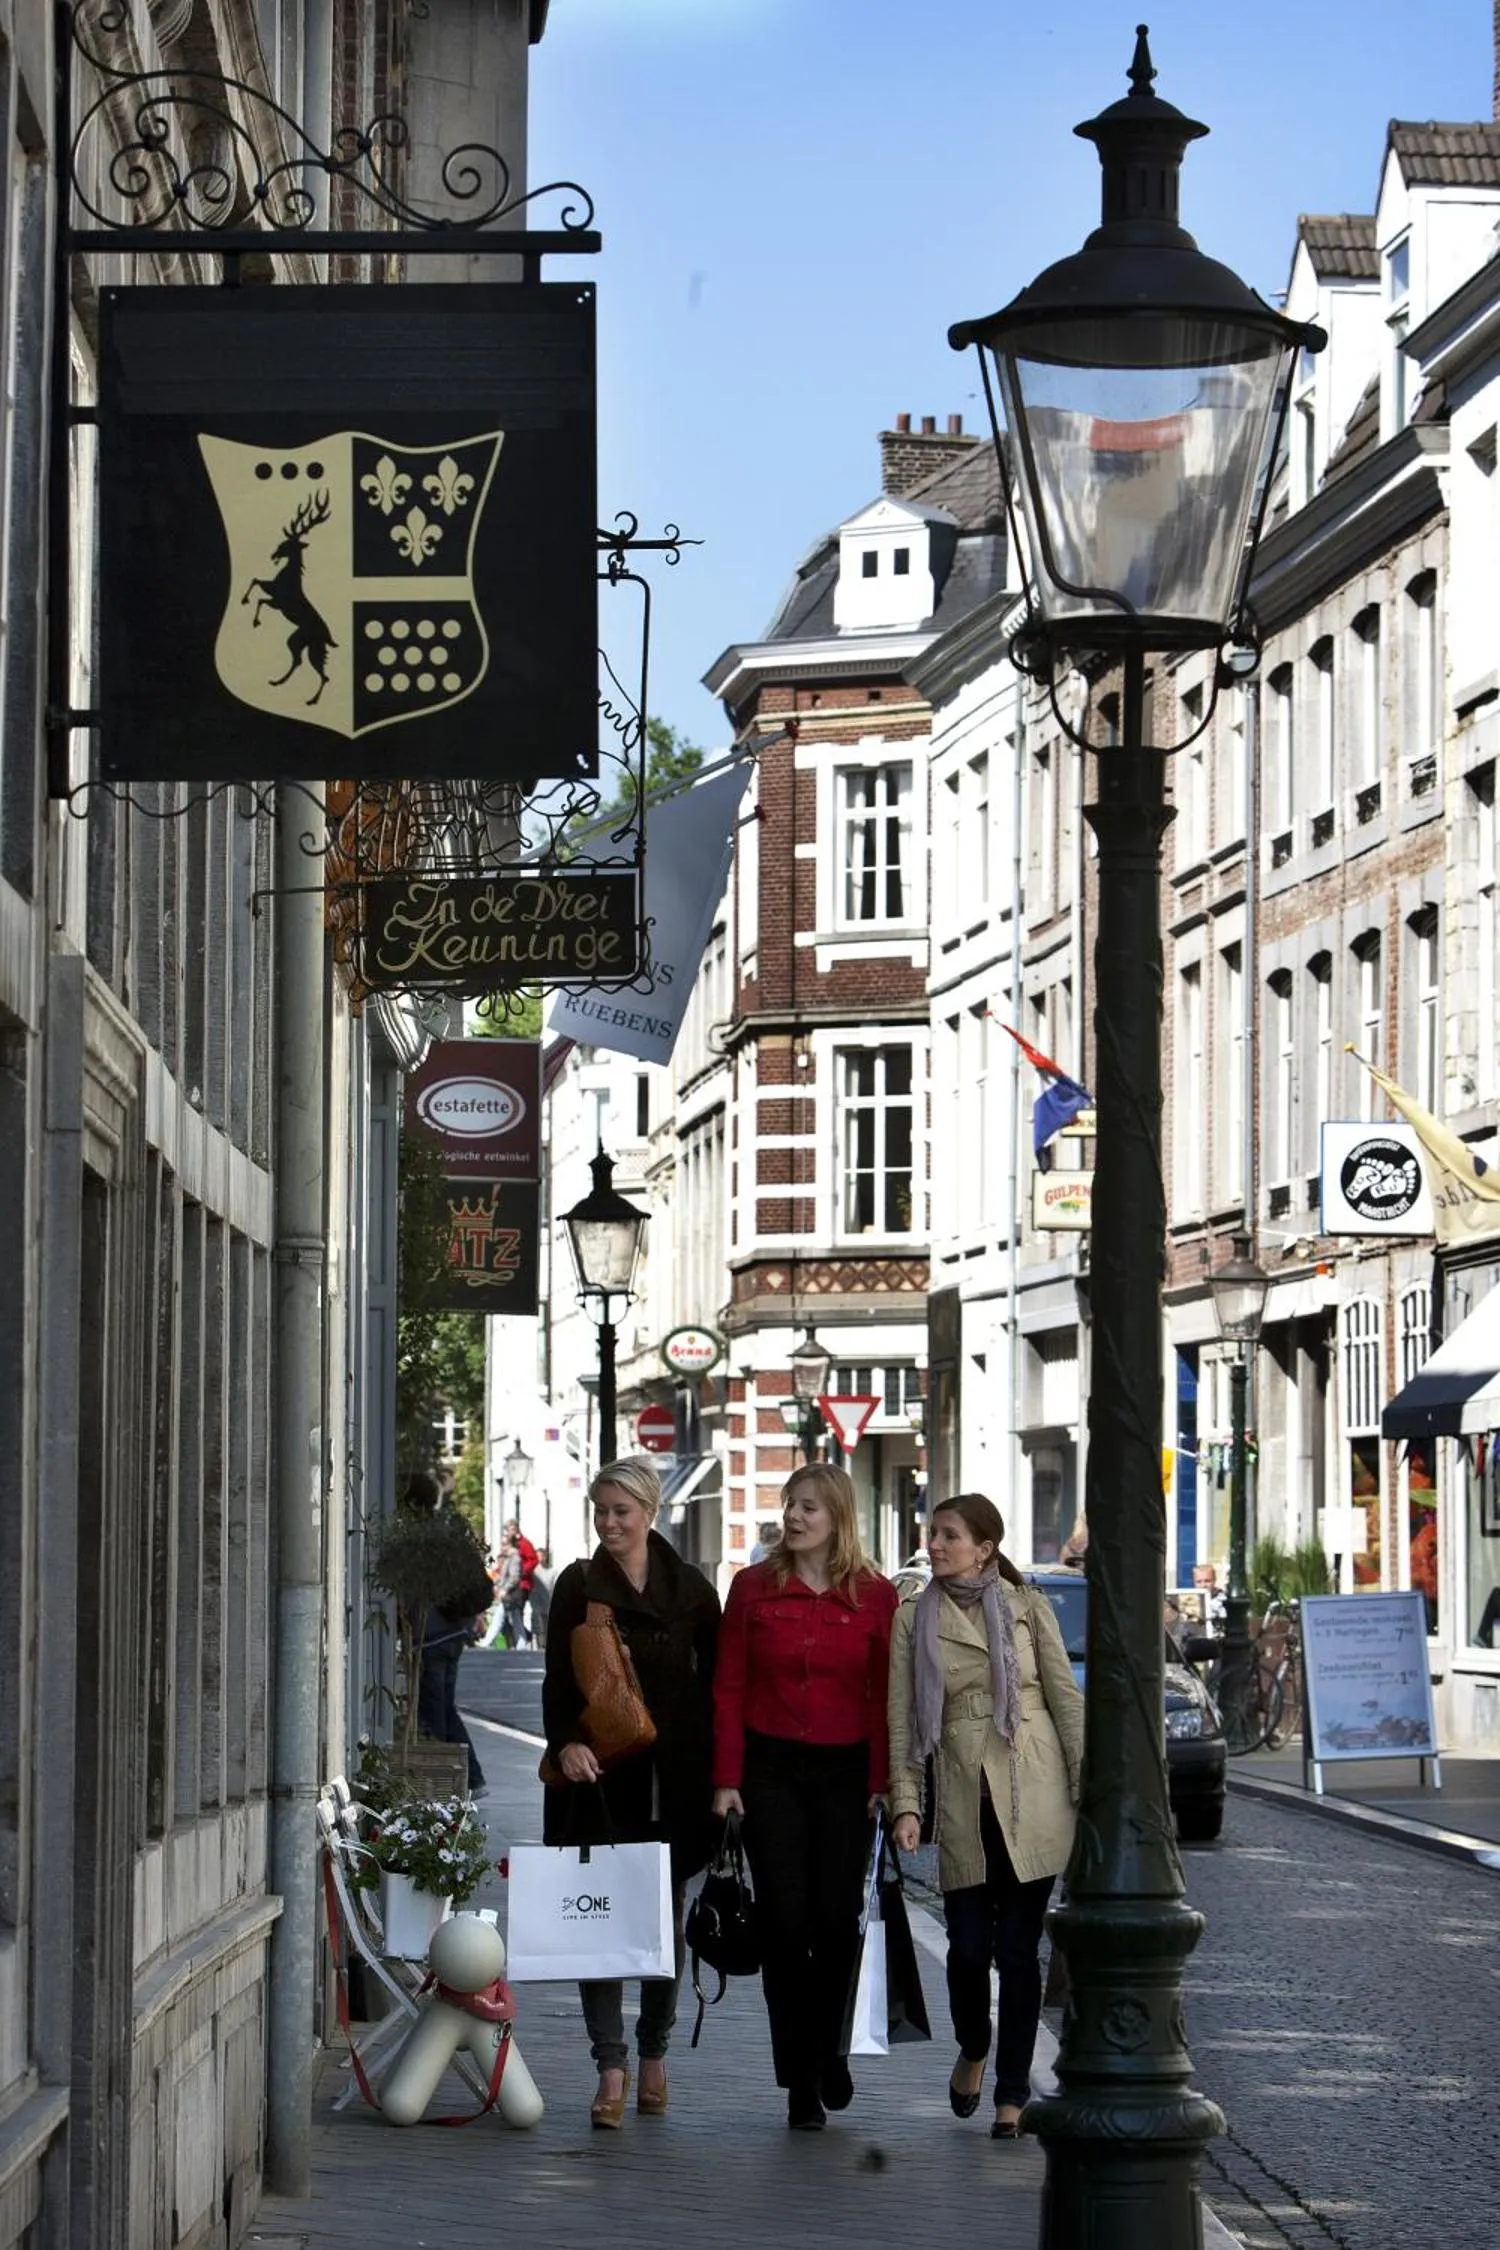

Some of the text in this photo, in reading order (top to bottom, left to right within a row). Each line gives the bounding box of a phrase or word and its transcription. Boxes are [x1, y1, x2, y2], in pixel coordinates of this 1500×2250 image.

[393, 879, 612, 926] In de Drei
[376, 917, 622, 972] Keuninge
[564, 995, 674, 1039] RUEBENS
[433, 1097, 510, 1115] estafette
[1045, 1184, 1093, 1206] GULPEN
